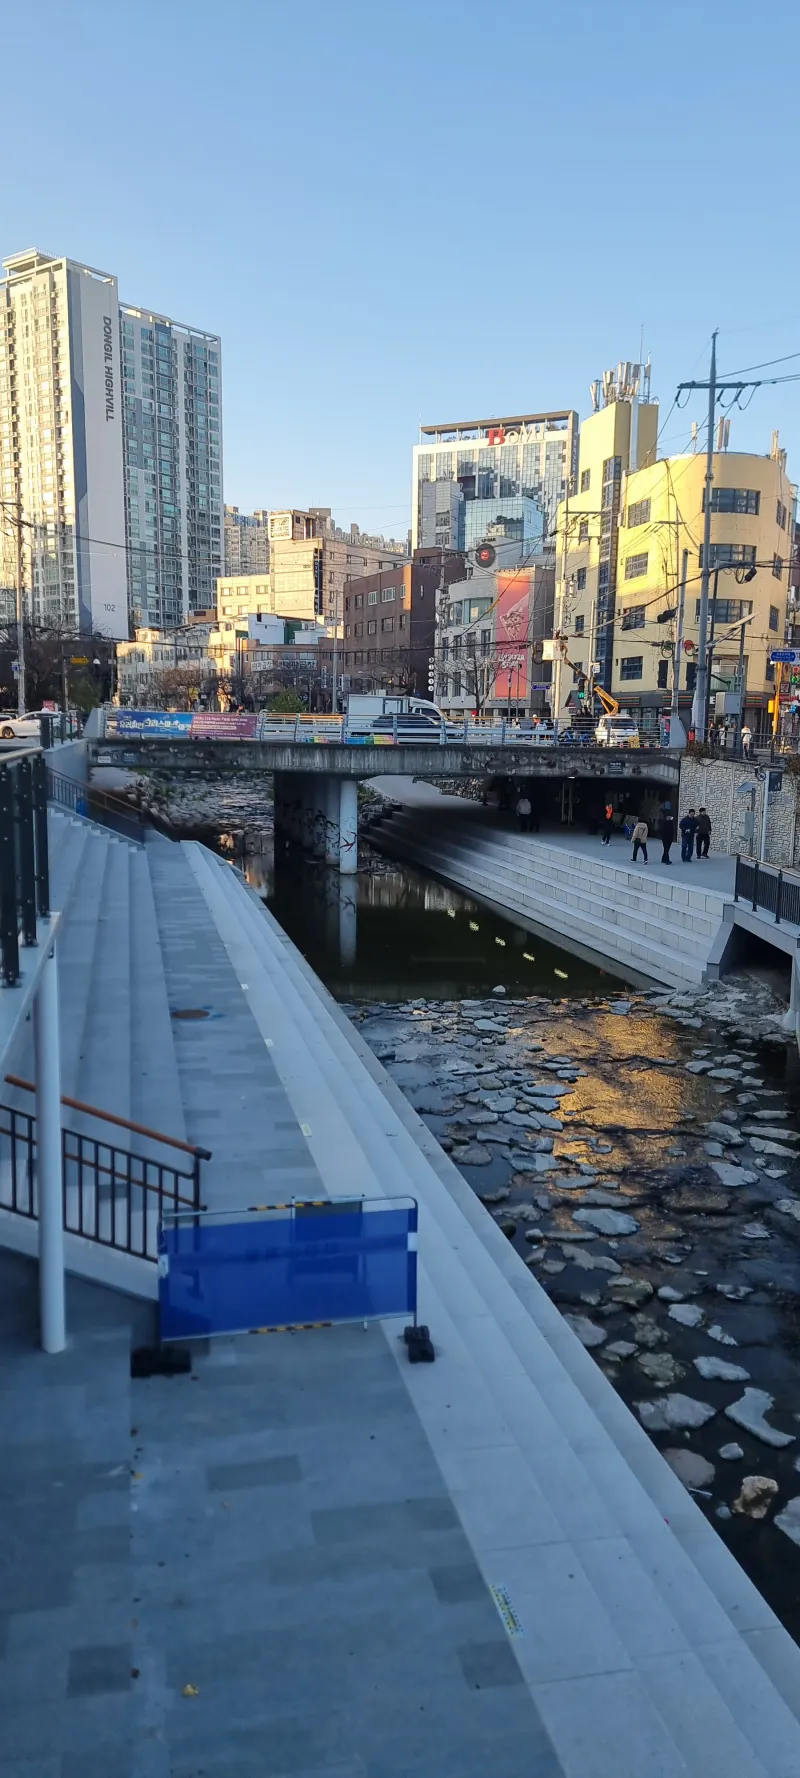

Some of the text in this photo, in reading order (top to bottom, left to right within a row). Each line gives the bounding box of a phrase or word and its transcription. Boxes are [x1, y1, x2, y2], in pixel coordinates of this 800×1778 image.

[103, 316, 114, 422] DONGIL HIGHVILL
[104, 603, 116, 612] 102
